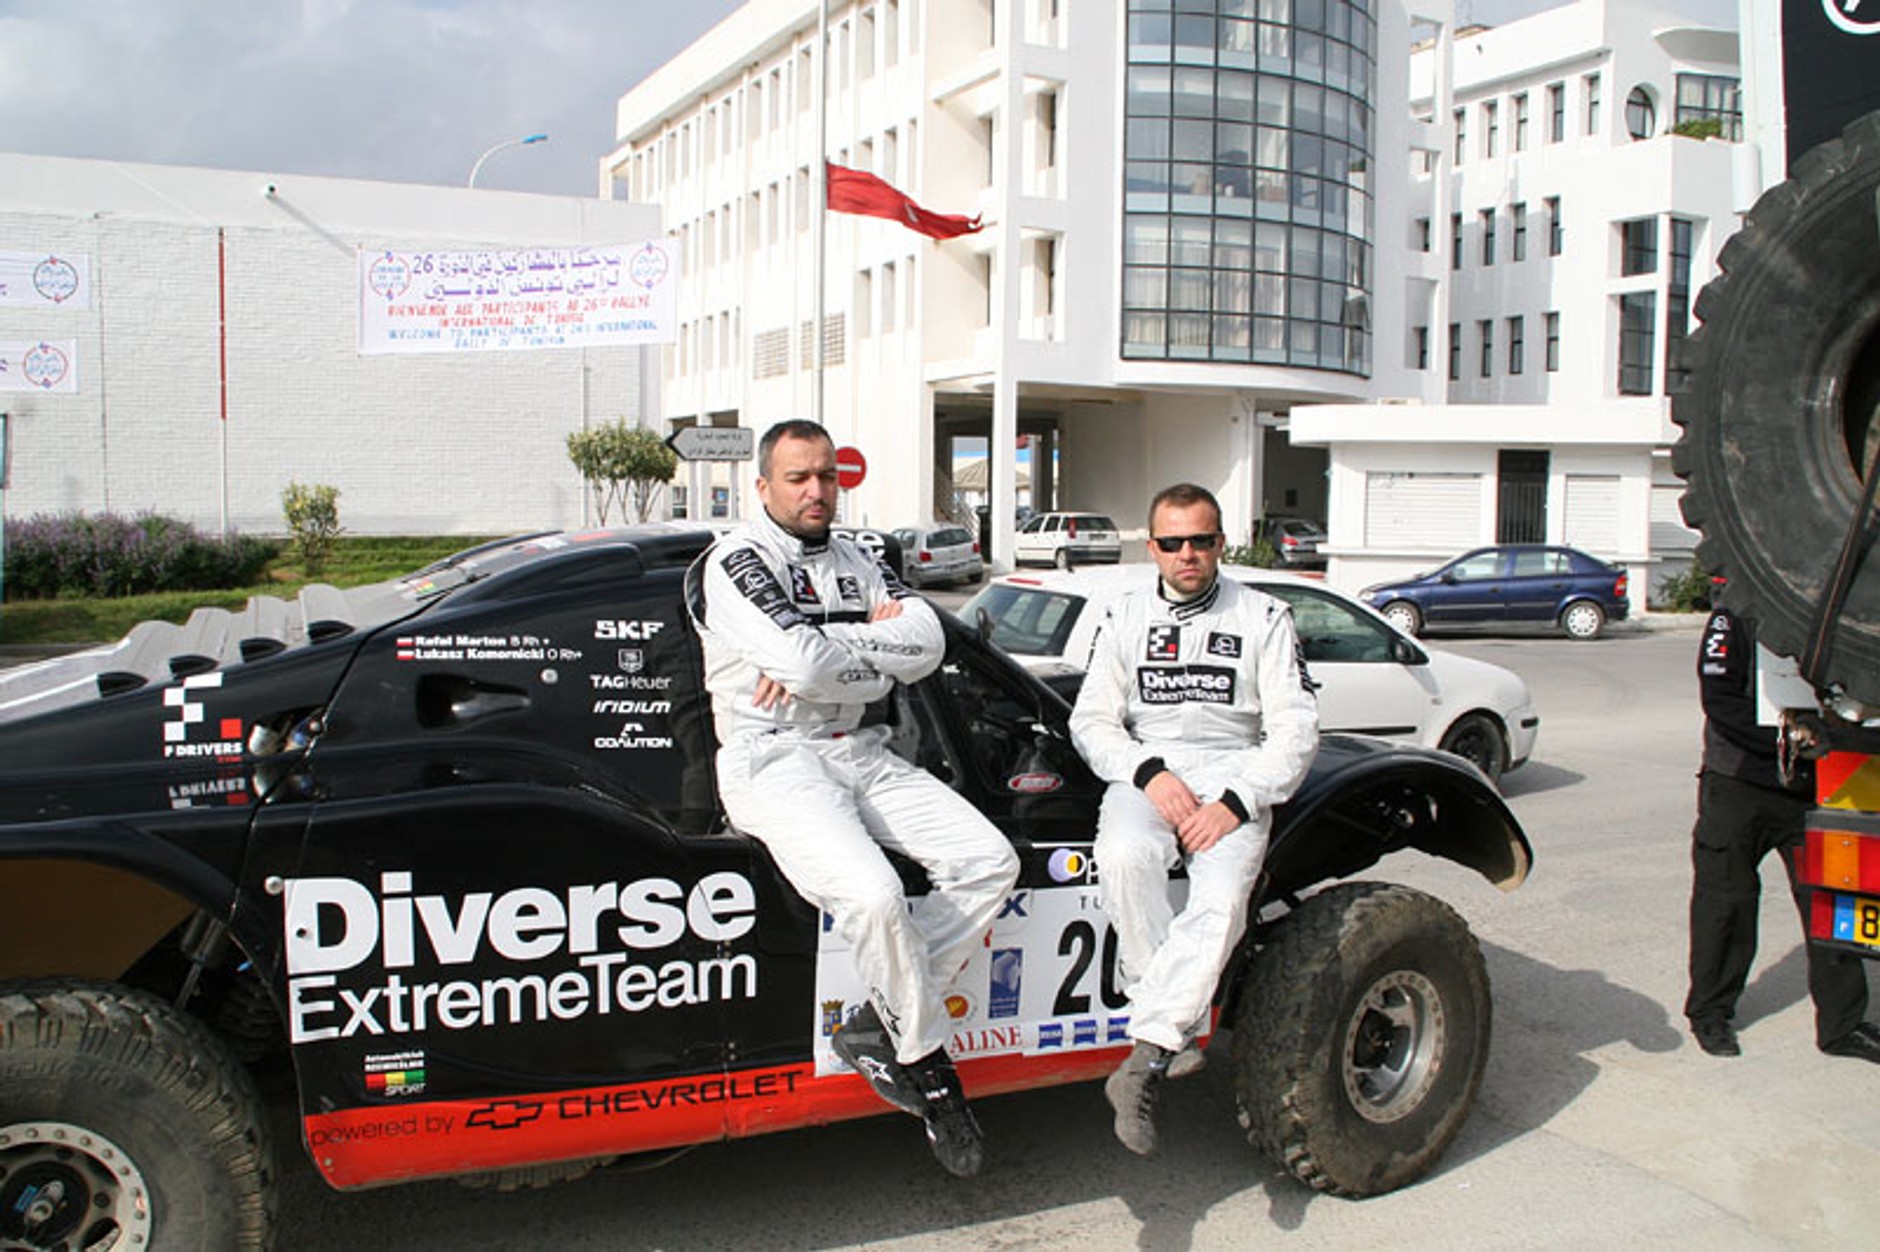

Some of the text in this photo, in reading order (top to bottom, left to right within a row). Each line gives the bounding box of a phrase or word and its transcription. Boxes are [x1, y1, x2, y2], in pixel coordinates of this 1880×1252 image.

[413, 254, 433, 274] 26
[594, 620, 664, 639] SKF
[1142, 670, 1231, 690] Diverse
[176, 742, 243, 756] DRIVERS
[284, 871, 756, 975] Diverse
[289, 952, 757, 1045] ExtremeTeam
[559, 1071, 803, 1120] CHEVROLET
[311, 1115, 455, 1147] powered by
